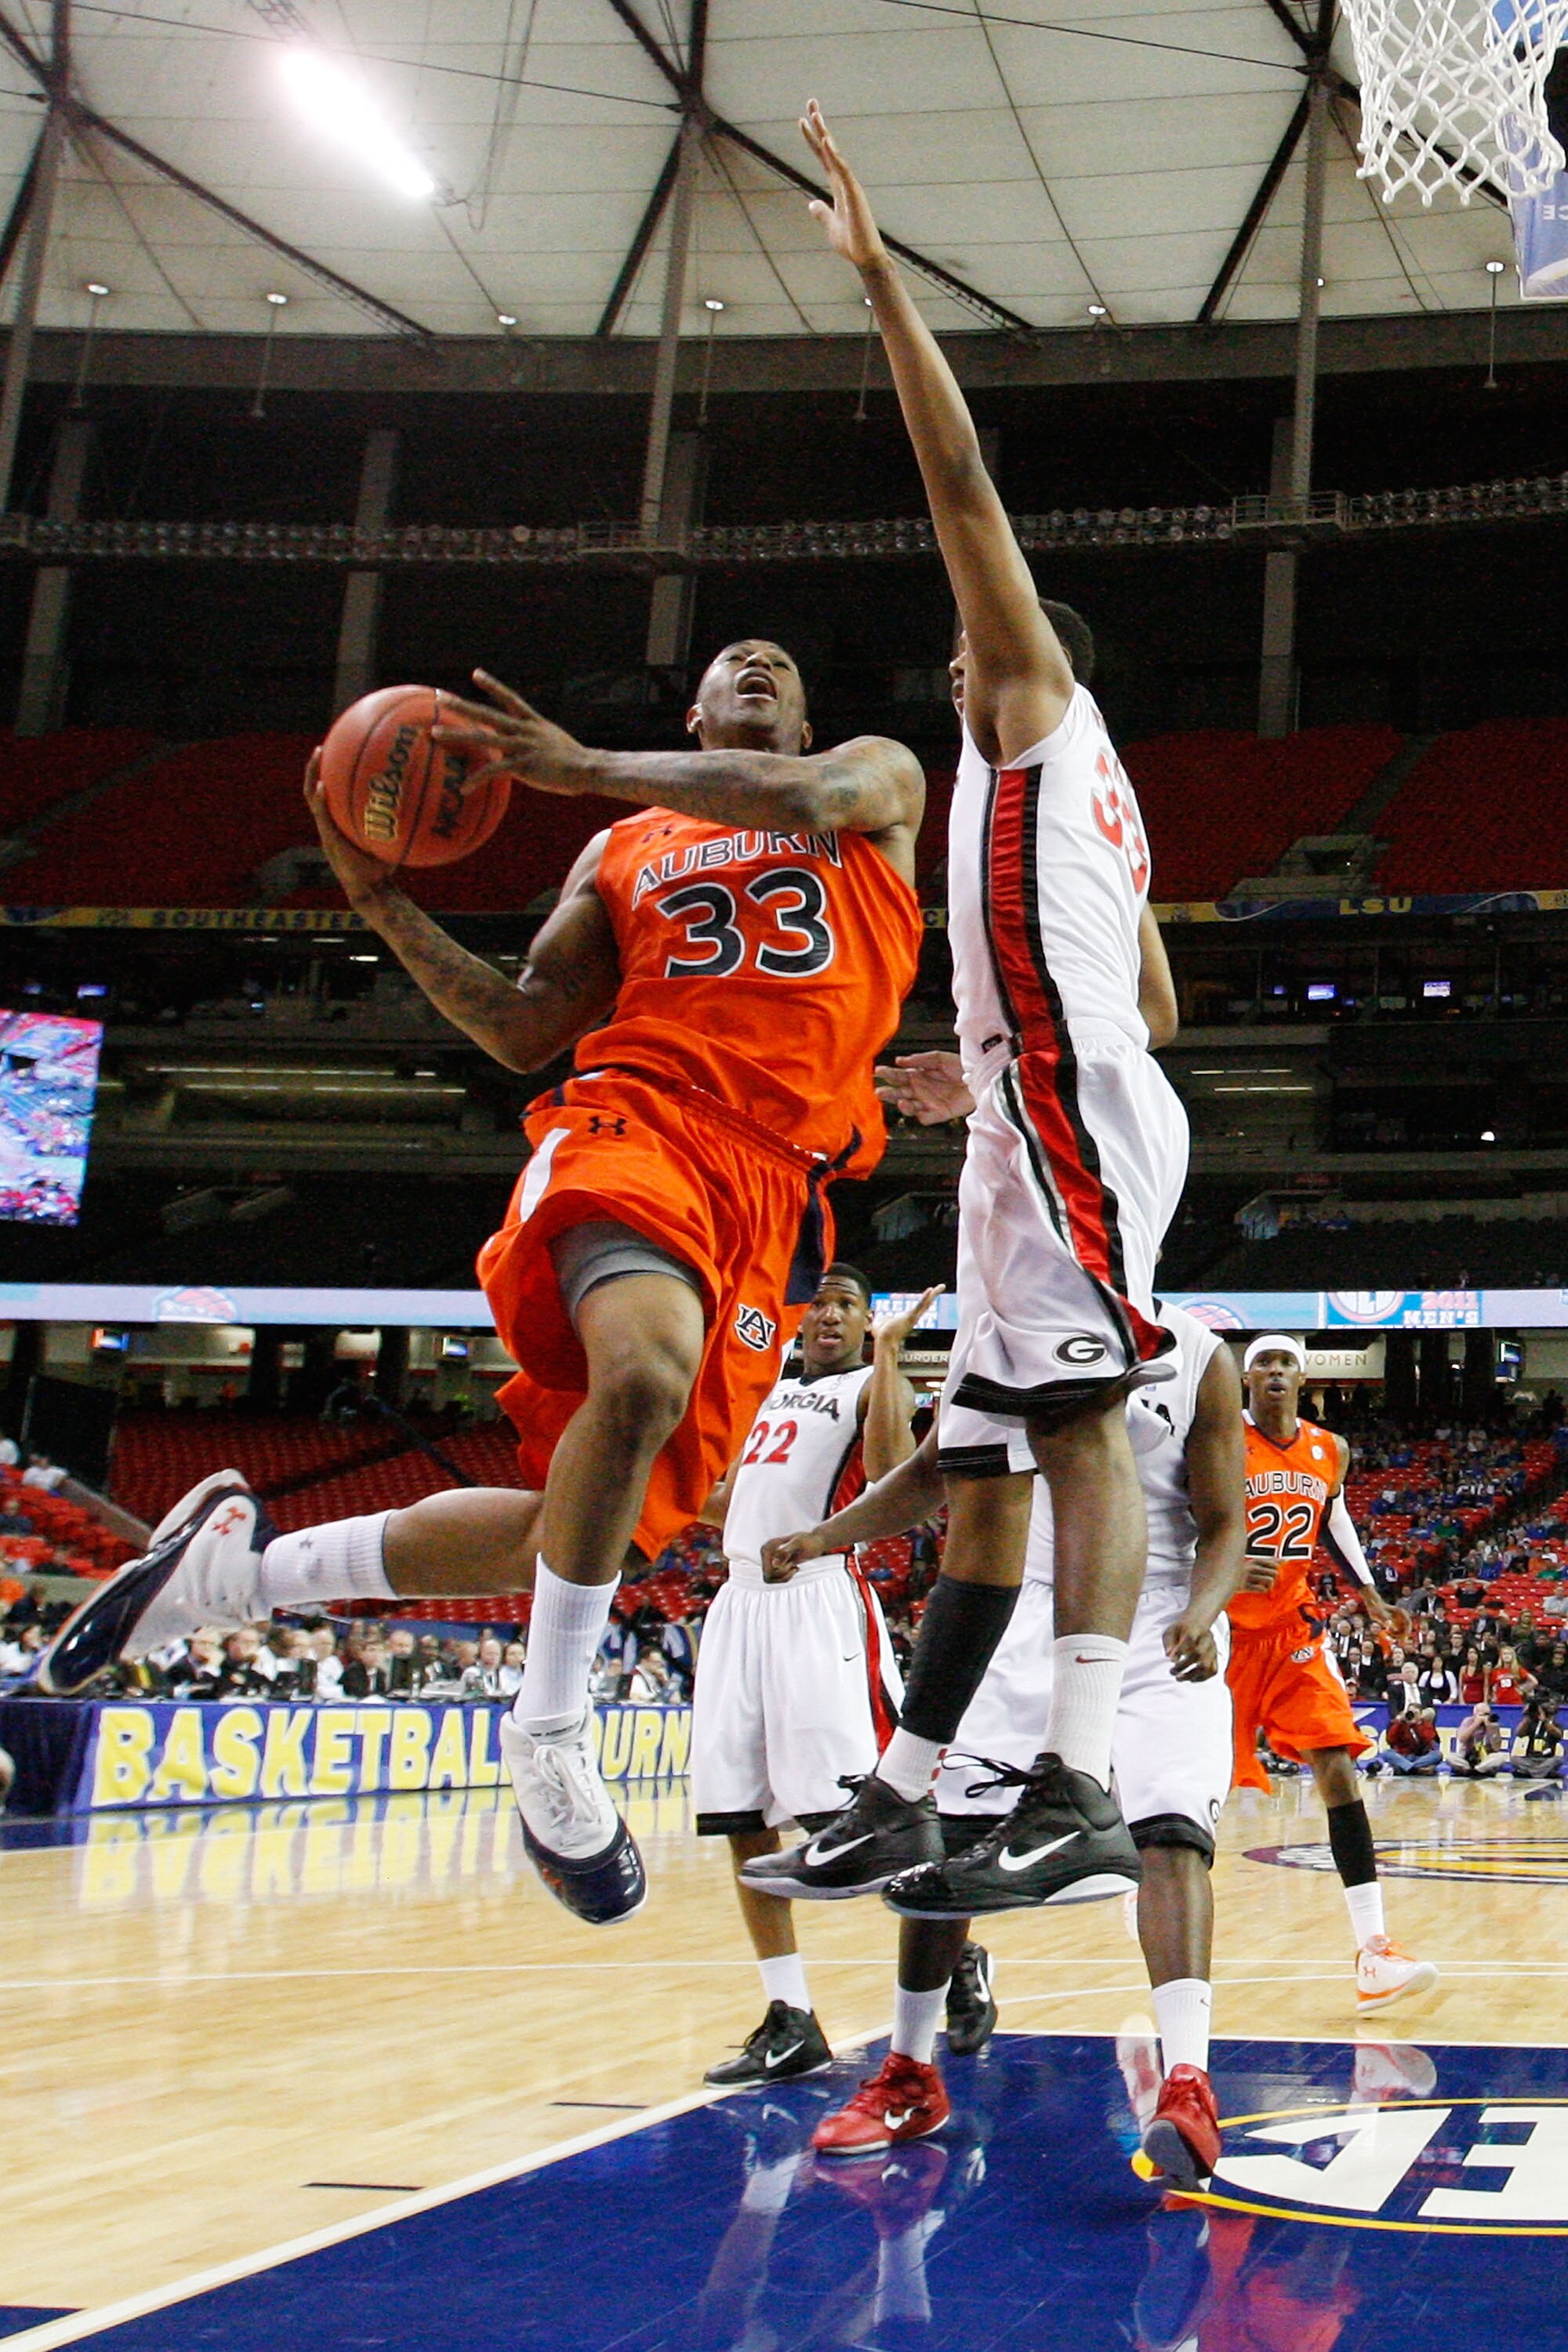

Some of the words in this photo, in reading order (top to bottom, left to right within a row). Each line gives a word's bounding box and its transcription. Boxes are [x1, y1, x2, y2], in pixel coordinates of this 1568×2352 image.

[364, 724, 418, 842] Wilson
[632, 828, 843, 912] AUBURN
[153, 909, 367, 930] SOUTHEASTER
[654, 866, 835, 978] 33
[1339, 897, 1412, 916] LSU
[1403, 1310, 1479, 1325] MEN'S
[1421, 1291, 1479, 1310] 2011
[1054, 1334, 1107, 1366] G
[742, 1420, 798, 1465] 22
[1245, 1470, 1327, 1505] AUBURN
[1243, 1503, 1313, 1560] 22
[90, 1707, 511, 1807] BASKETBAL
